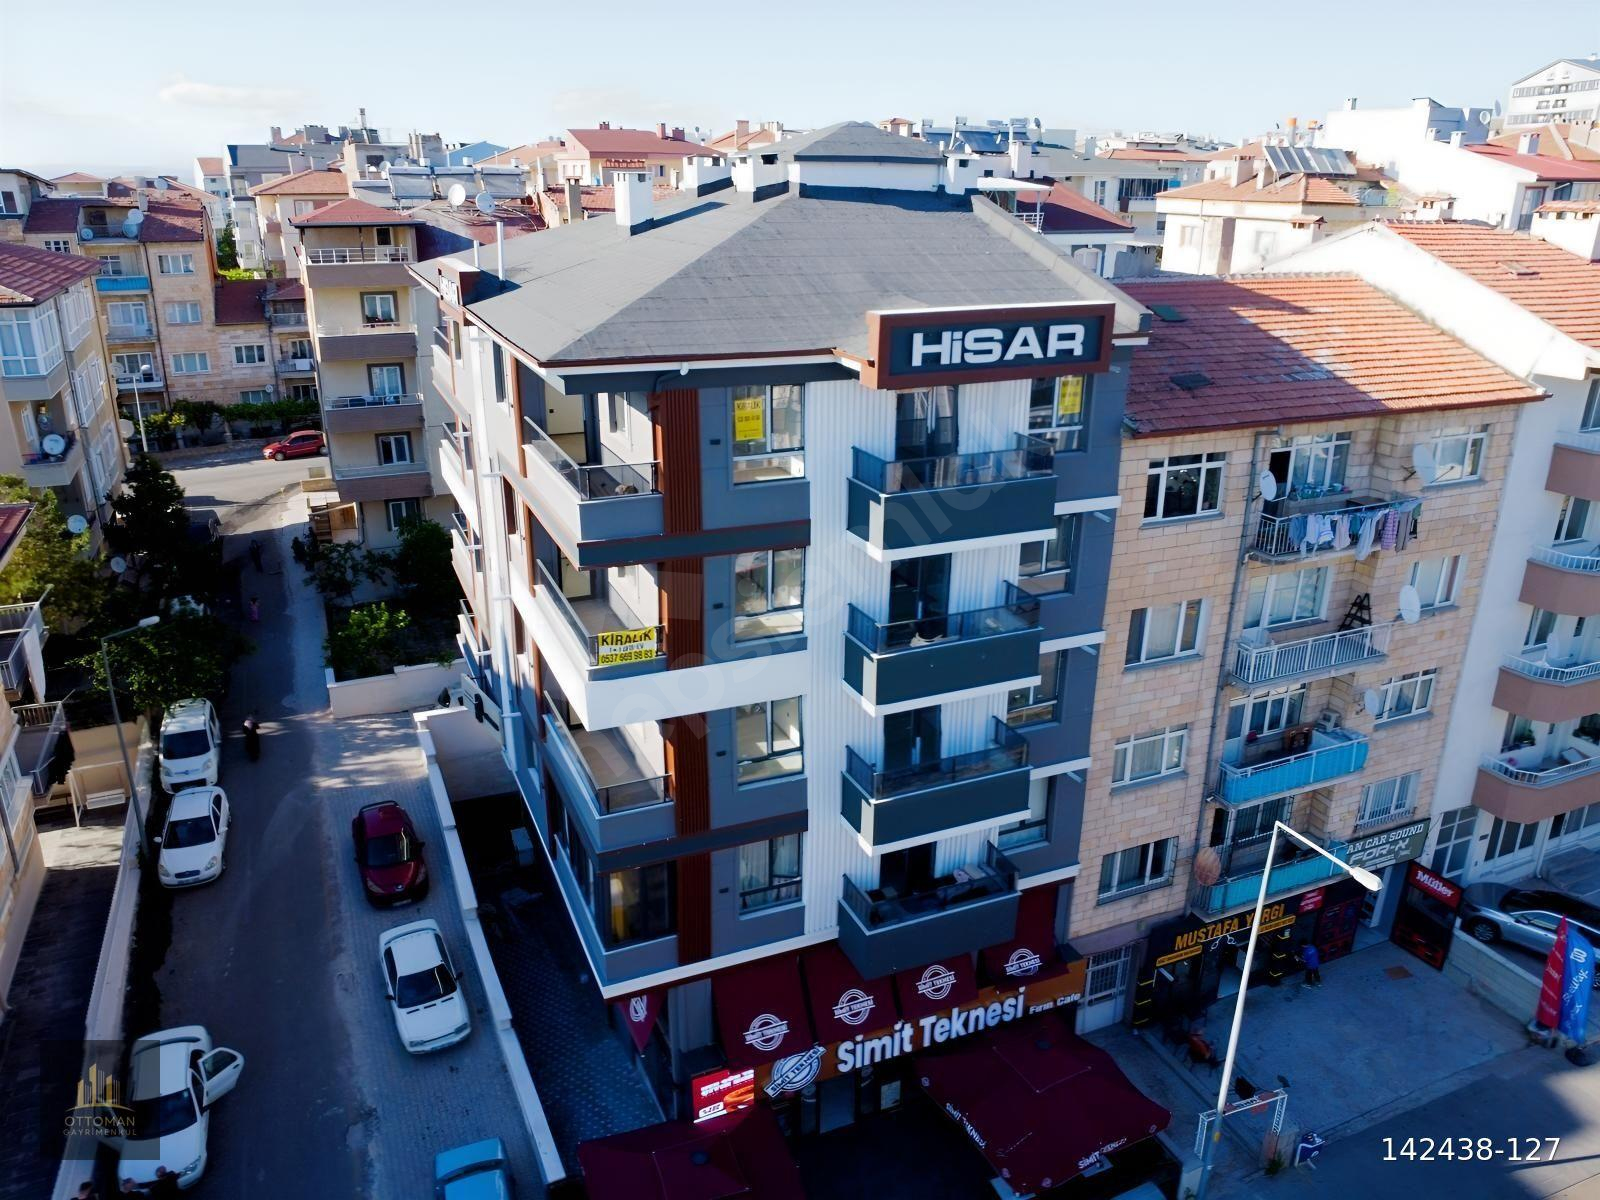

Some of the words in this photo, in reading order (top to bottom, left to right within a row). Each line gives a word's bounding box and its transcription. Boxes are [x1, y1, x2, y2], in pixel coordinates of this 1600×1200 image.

[1365, 834, 1387, 849] CAR
[1389, 823, 1424, 842] SOUND
[1175, 917, 1239, 951] MUSTAFA
[837, 1019, 914, 1073] Simit
[919, 986, 1026, 1048] Teknesi
